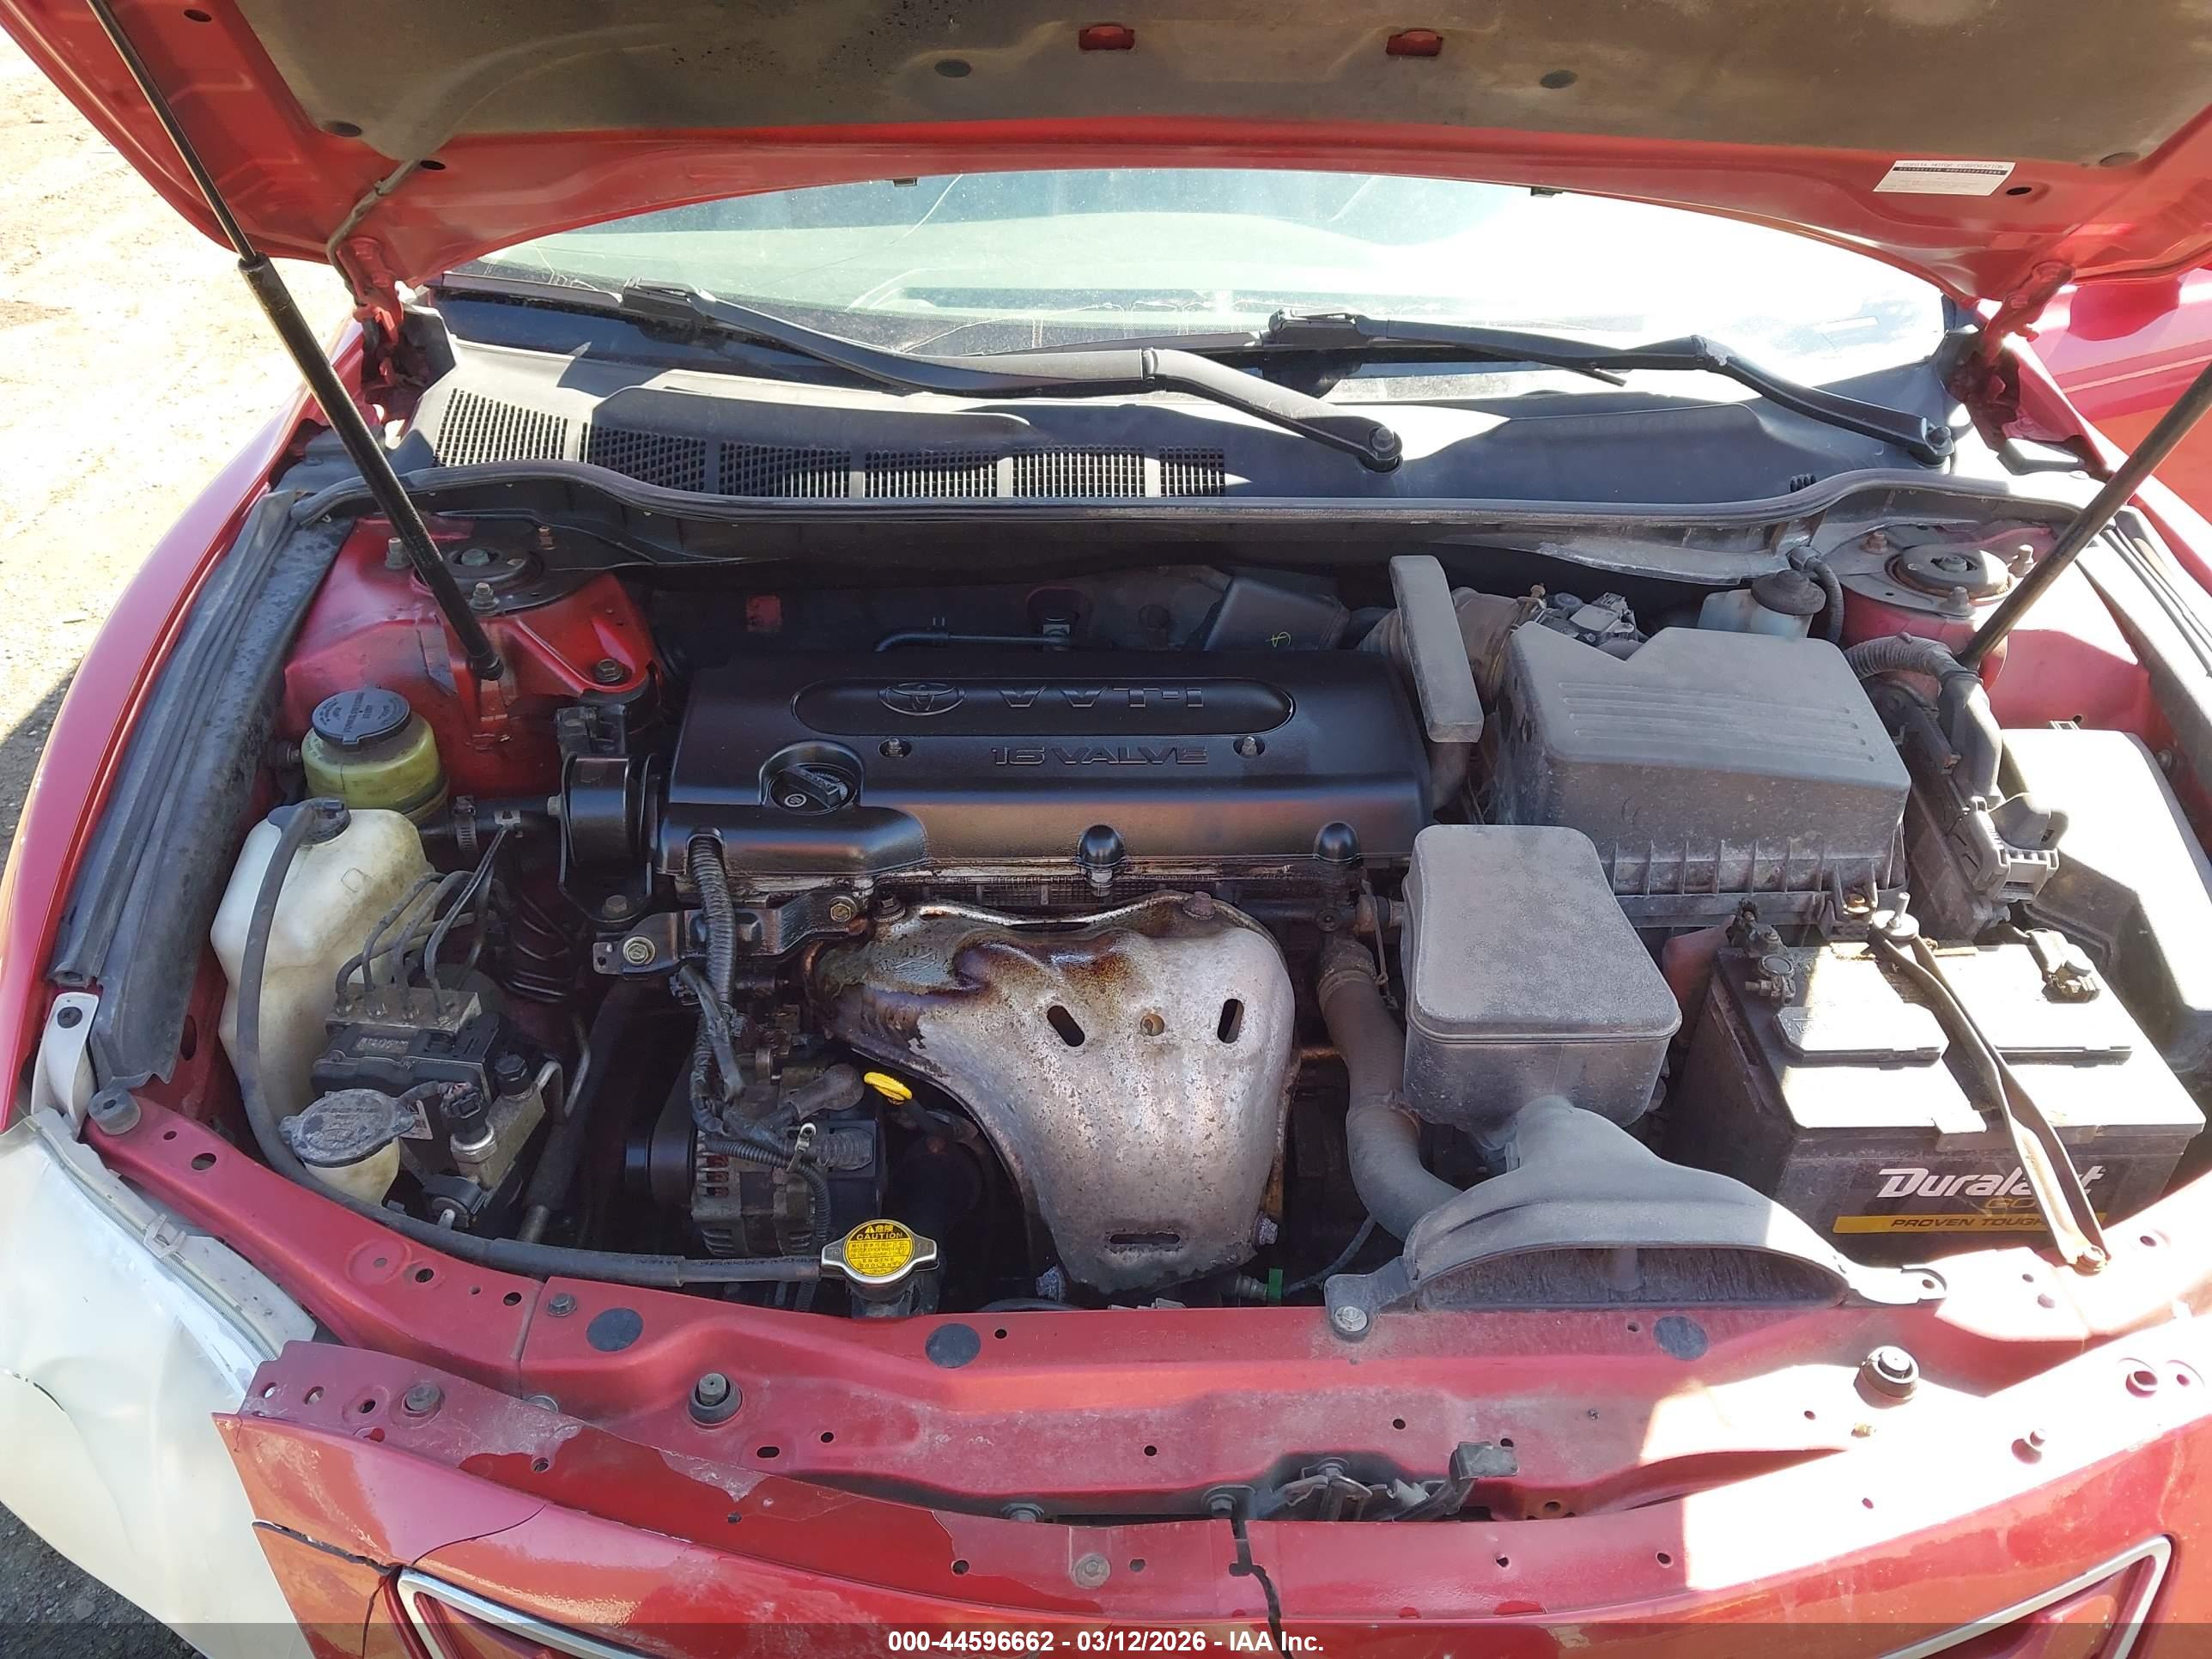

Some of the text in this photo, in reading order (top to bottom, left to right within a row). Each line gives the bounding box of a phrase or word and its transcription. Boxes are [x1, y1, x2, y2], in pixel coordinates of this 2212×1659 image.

[990, 745, 1209, 765] 16 VALVE
[1876, 1165, 2106, 1199] Duralat
[1891, 1218, 1975, 1228] PROVEN
[856, 1232, 903, 1241] CAUTION
